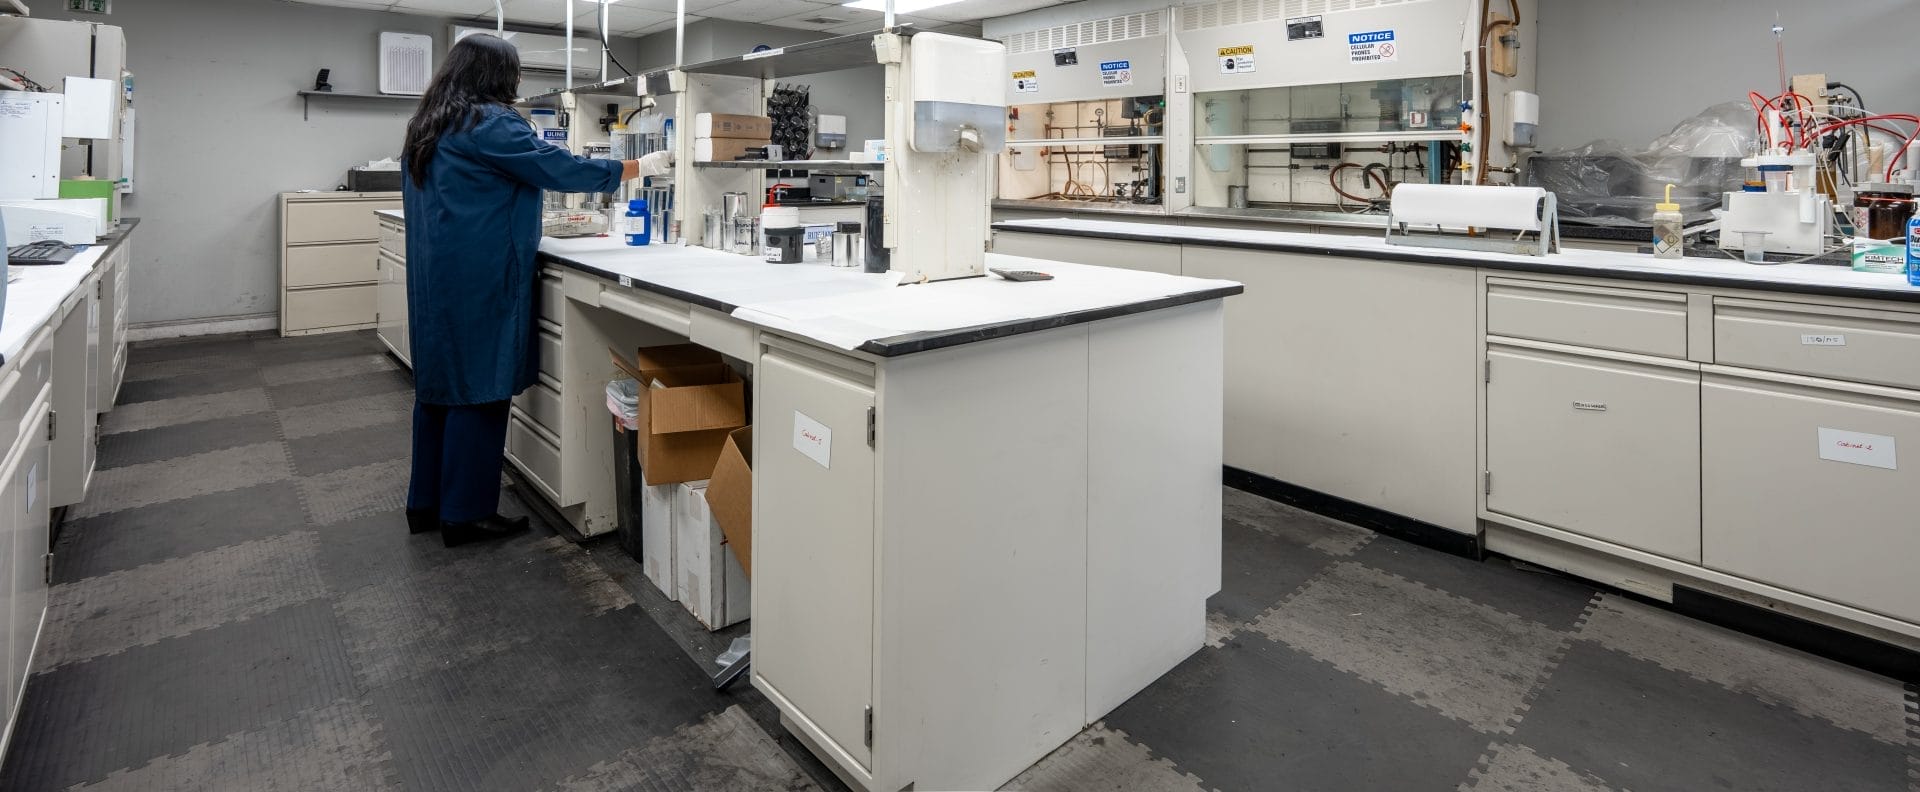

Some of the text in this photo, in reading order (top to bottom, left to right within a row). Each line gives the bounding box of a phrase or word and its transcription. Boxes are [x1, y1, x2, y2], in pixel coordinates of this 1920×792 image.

[1352, 33, 1392, 42] NOTICE
[1225, 47, 1252, 55] CAUTION
[1102, 62, 1128, 70] NOTICE
[1865, 255, 1904, 263] KIMTECH
